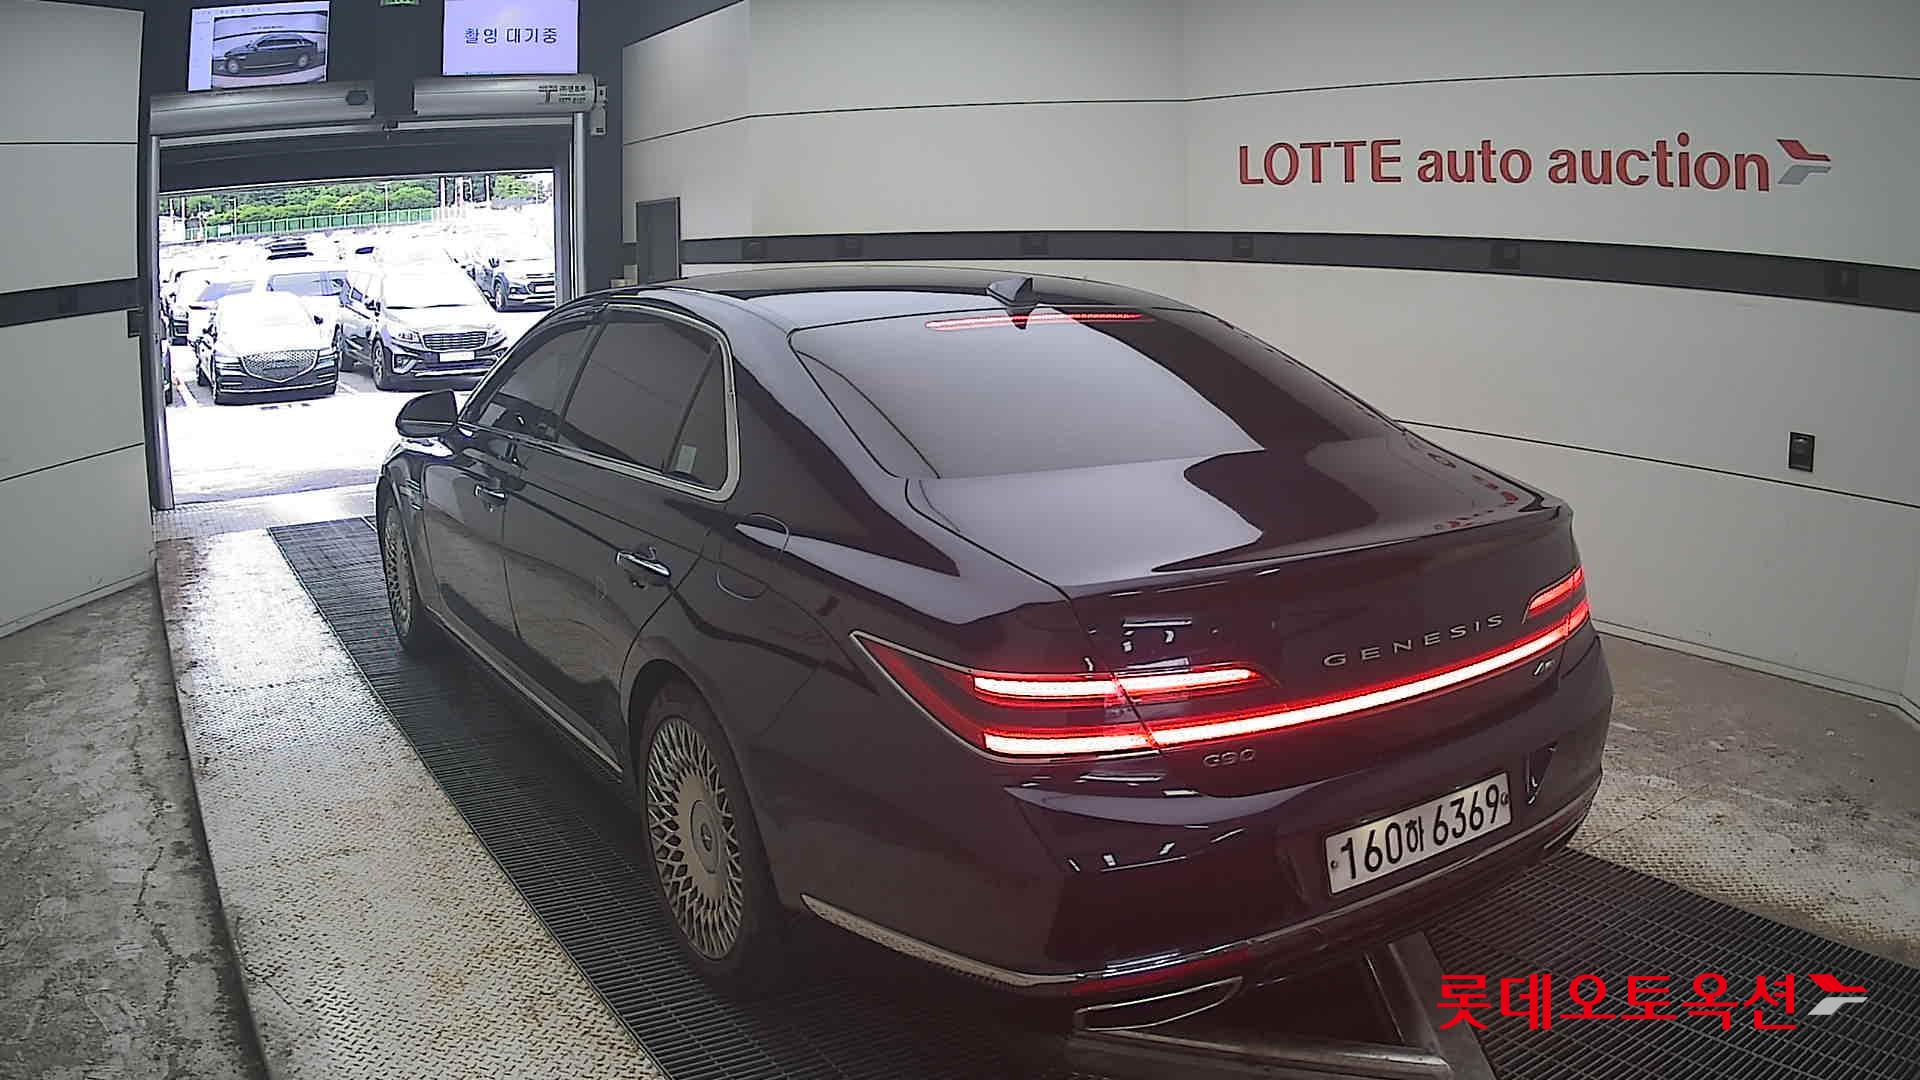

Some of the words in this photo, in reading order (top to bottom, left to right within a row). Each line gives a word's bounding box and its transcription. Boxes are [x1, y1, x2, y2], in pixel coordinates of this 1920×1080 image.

[464, 27, 498, 45] 촬영
[505, 27, 558, 45] 대기중
[1239, 138, 1402, 186] LOTTE
[1416, 138, 1533, 186] auto
[1547, 132, 1770, 193] auction
[1323, 614, 1505, 668] GENESIS
[1202, 747, 1257, 769] G90
